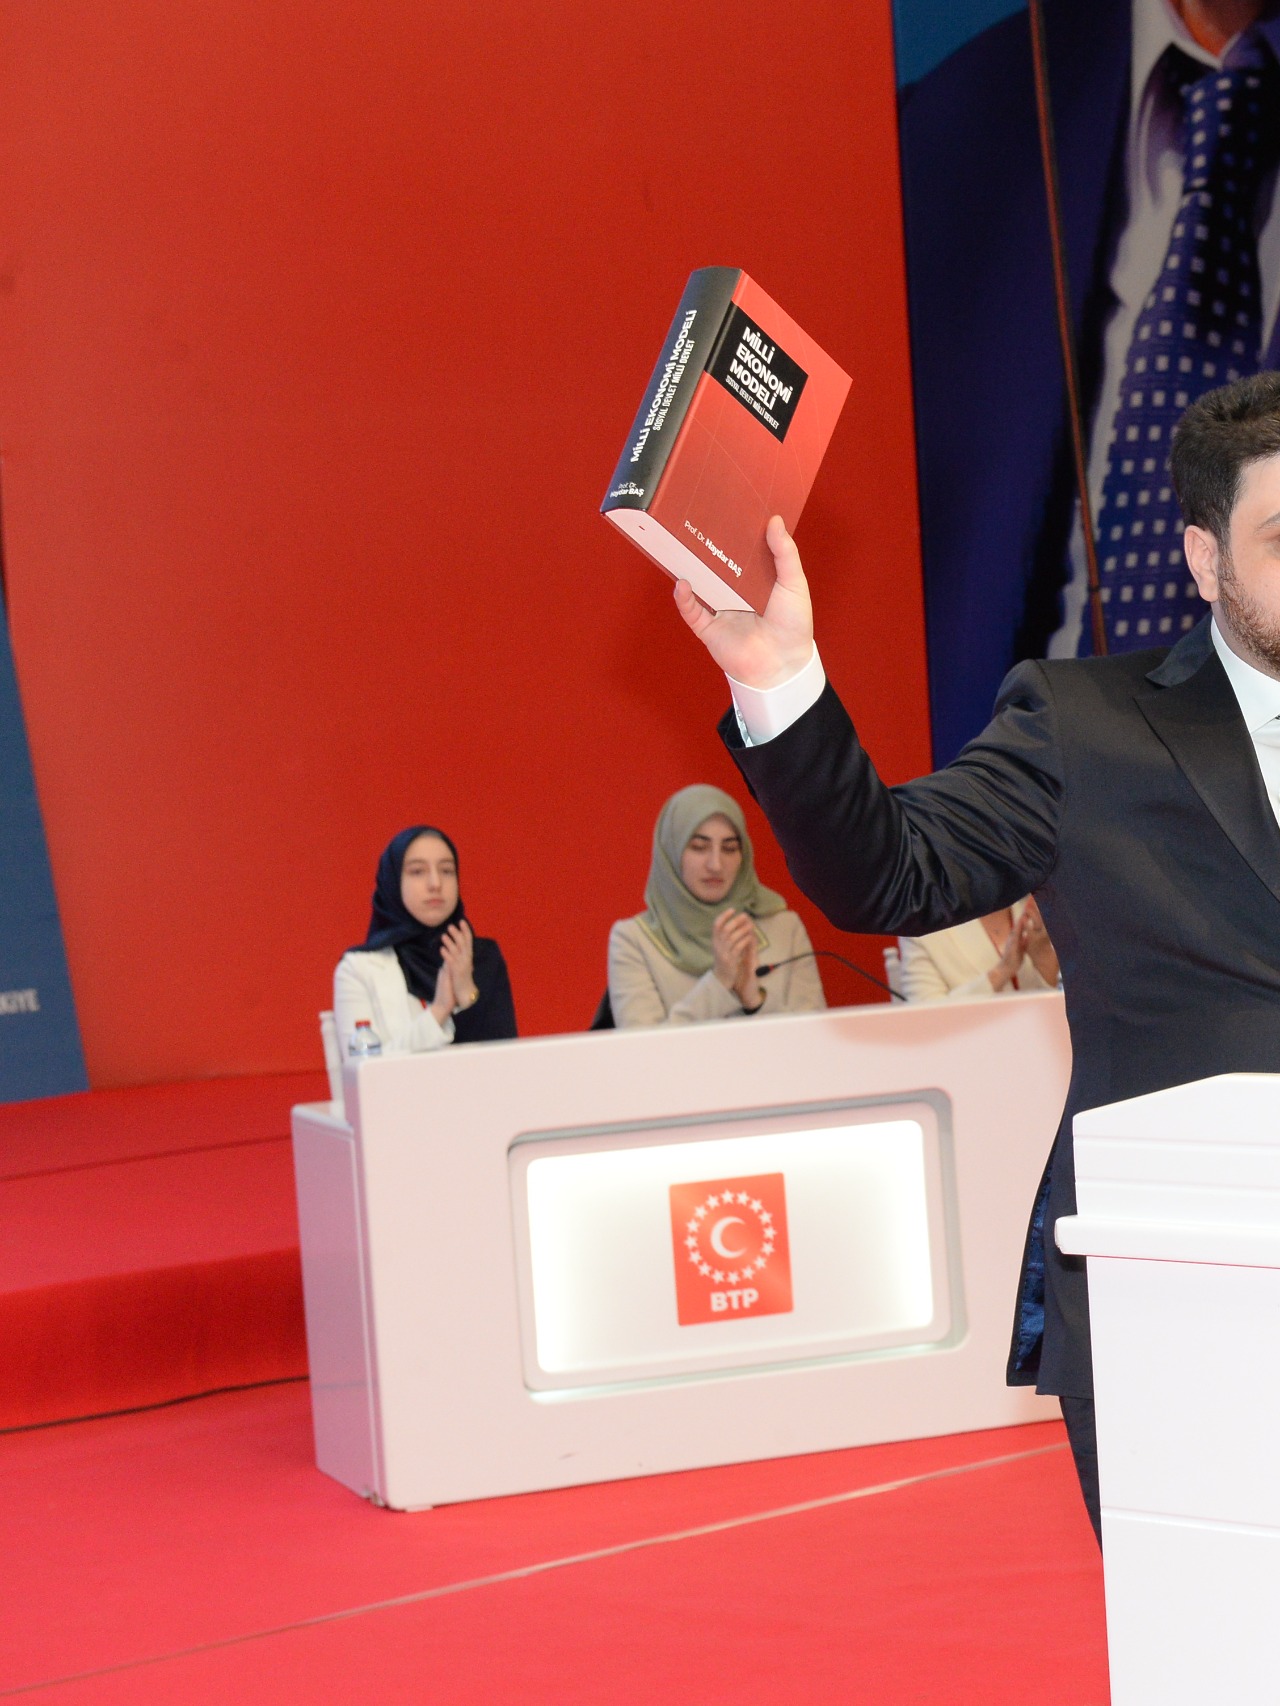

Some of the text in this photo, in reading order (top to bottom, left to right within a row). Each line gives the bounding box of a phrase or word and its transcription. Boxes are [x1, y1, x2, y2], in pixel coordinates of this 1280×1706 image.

[736, 342, 794, 404] EKONOMİ
[742, 326, 776, 364] MİLLİ
[630, 310, 697, 462] MİLLİ EKONOMİ MODELİ
[653, 407, 668, 431] SOSYAL
[679, 339, 695, 364] DEVLET
[729, 358, 778, 410] MODELİ
[684, 520, 743, 578] Prof. Dr. Haydar BAŞ
[710, 1287, 760, 1312] BTP
